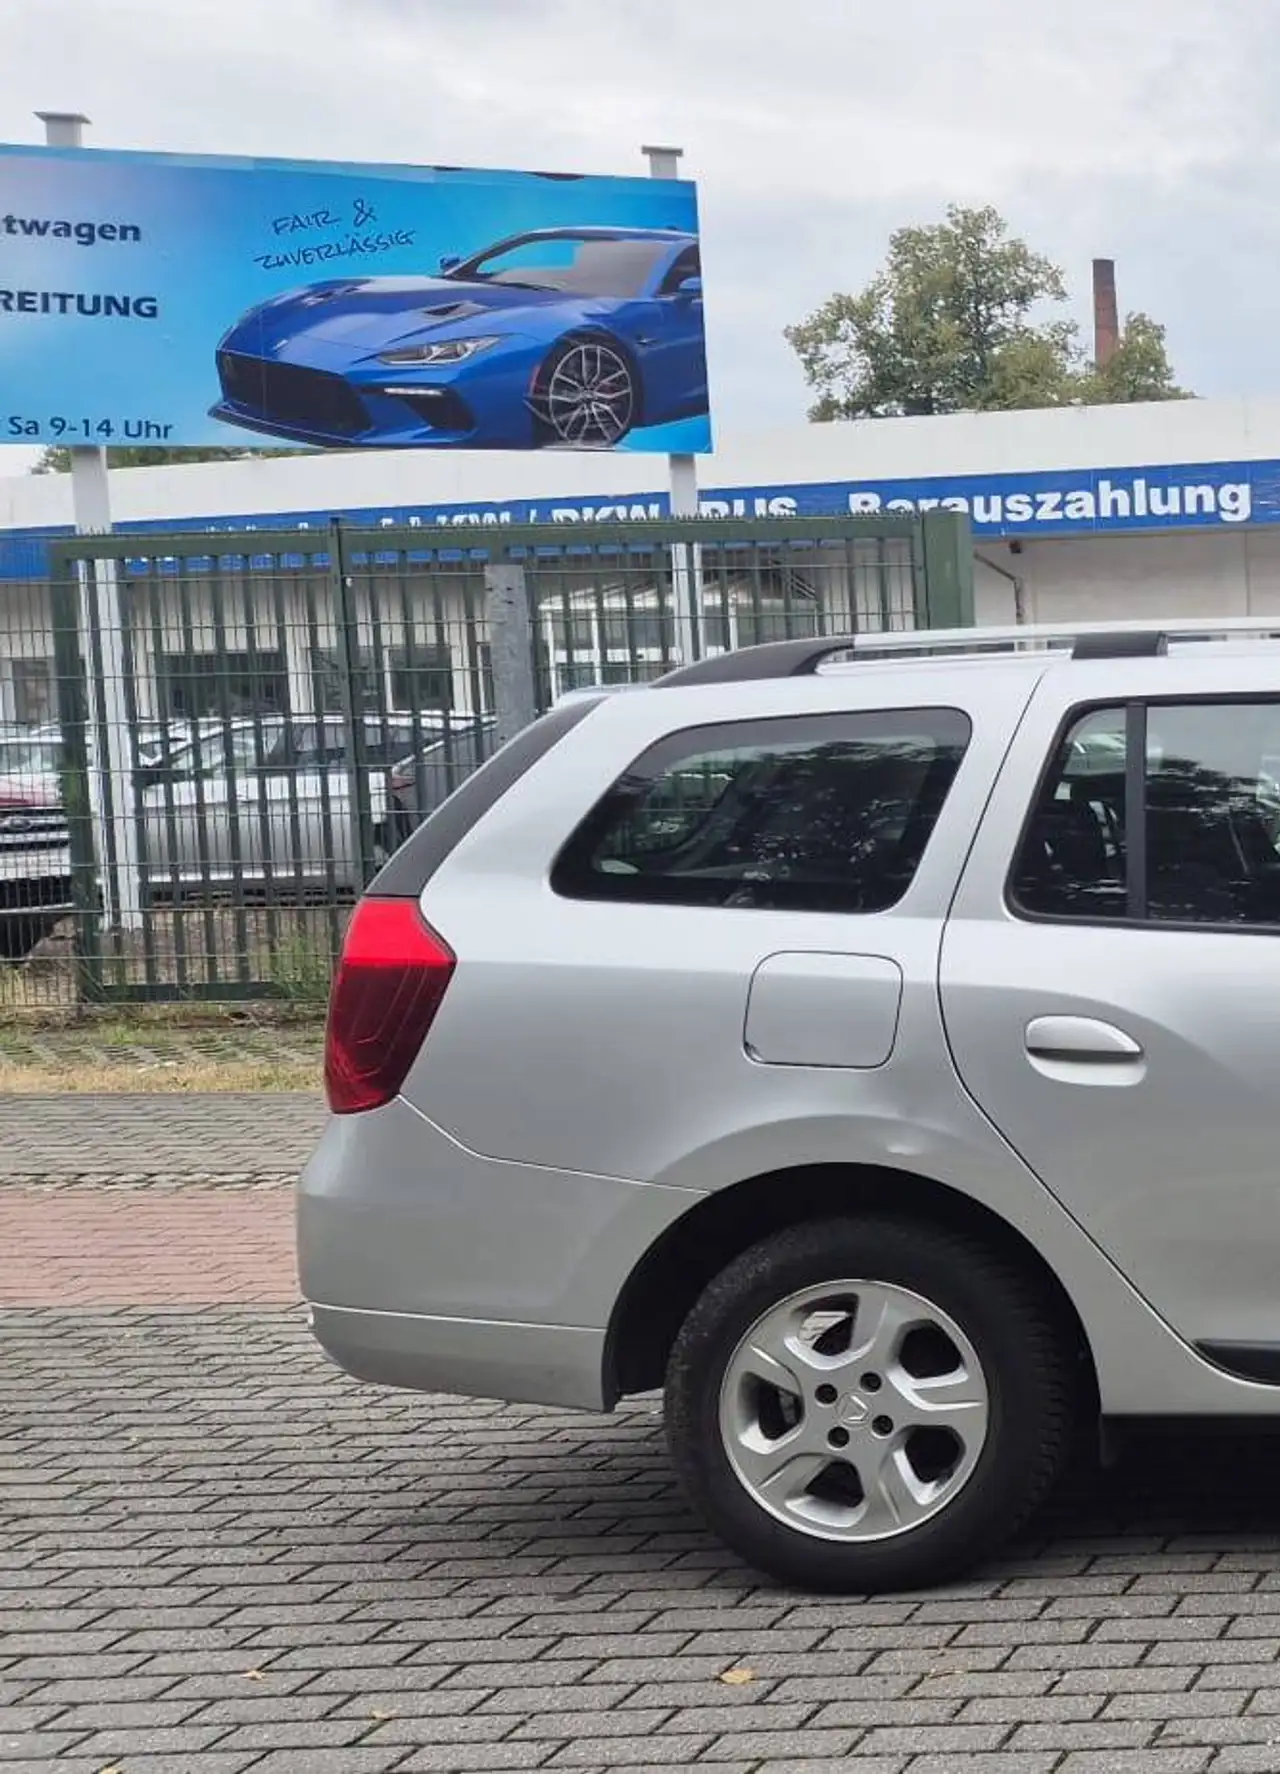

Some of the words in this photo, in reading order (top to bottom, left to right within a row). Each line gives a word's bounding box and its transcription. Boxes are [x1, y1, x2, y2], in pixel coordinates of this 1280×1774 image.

[2, 215, 142, 246] twagen
[272, 211, 342, 235] FAIR
[353, 198, 377, 227] &
[253, 230, 416, 269] ZUVERLÄSSIG
[8, 416, 39, 435] Sa
[50, 416, 114, 437] 9-14
[124, 419, 173, 439] Uhr
